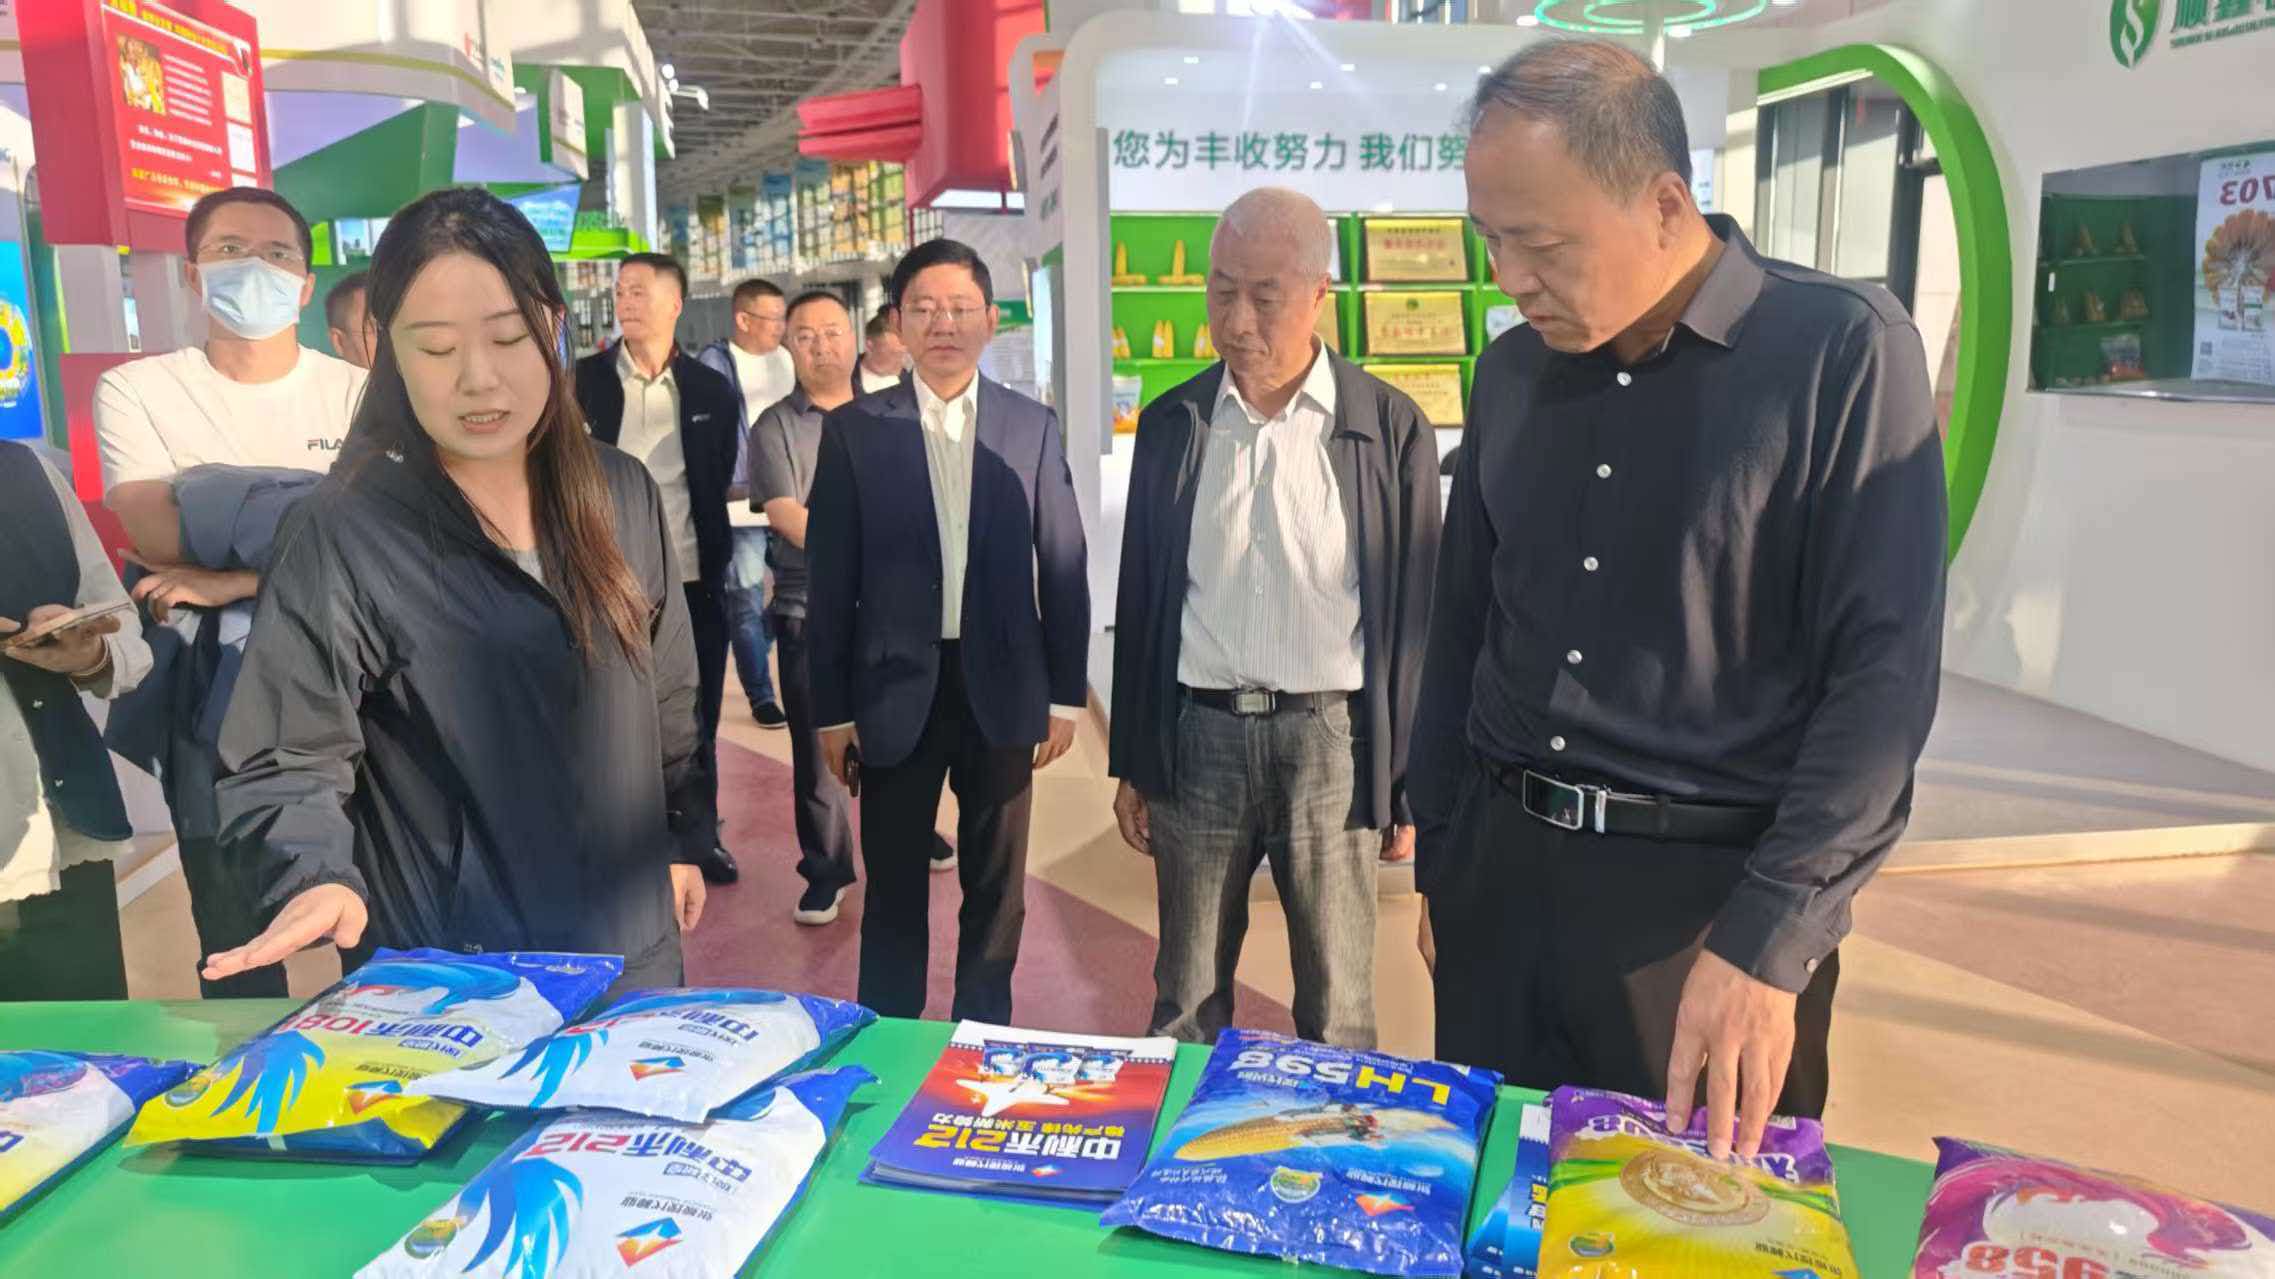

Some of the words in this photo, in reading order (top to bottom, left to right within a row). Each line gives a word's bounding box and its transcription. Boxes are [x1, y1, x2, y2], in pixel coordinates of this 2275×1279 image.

[1113, 129, 1347, 171] 您为丰收努力
[306, 438, 344, 450] FILA
[1226, 1050, 1451, 1105] LH598
[517, 1131, 752, 1183] 中利禾212
[912, 1124, 1122, 1160] 中利禾212
